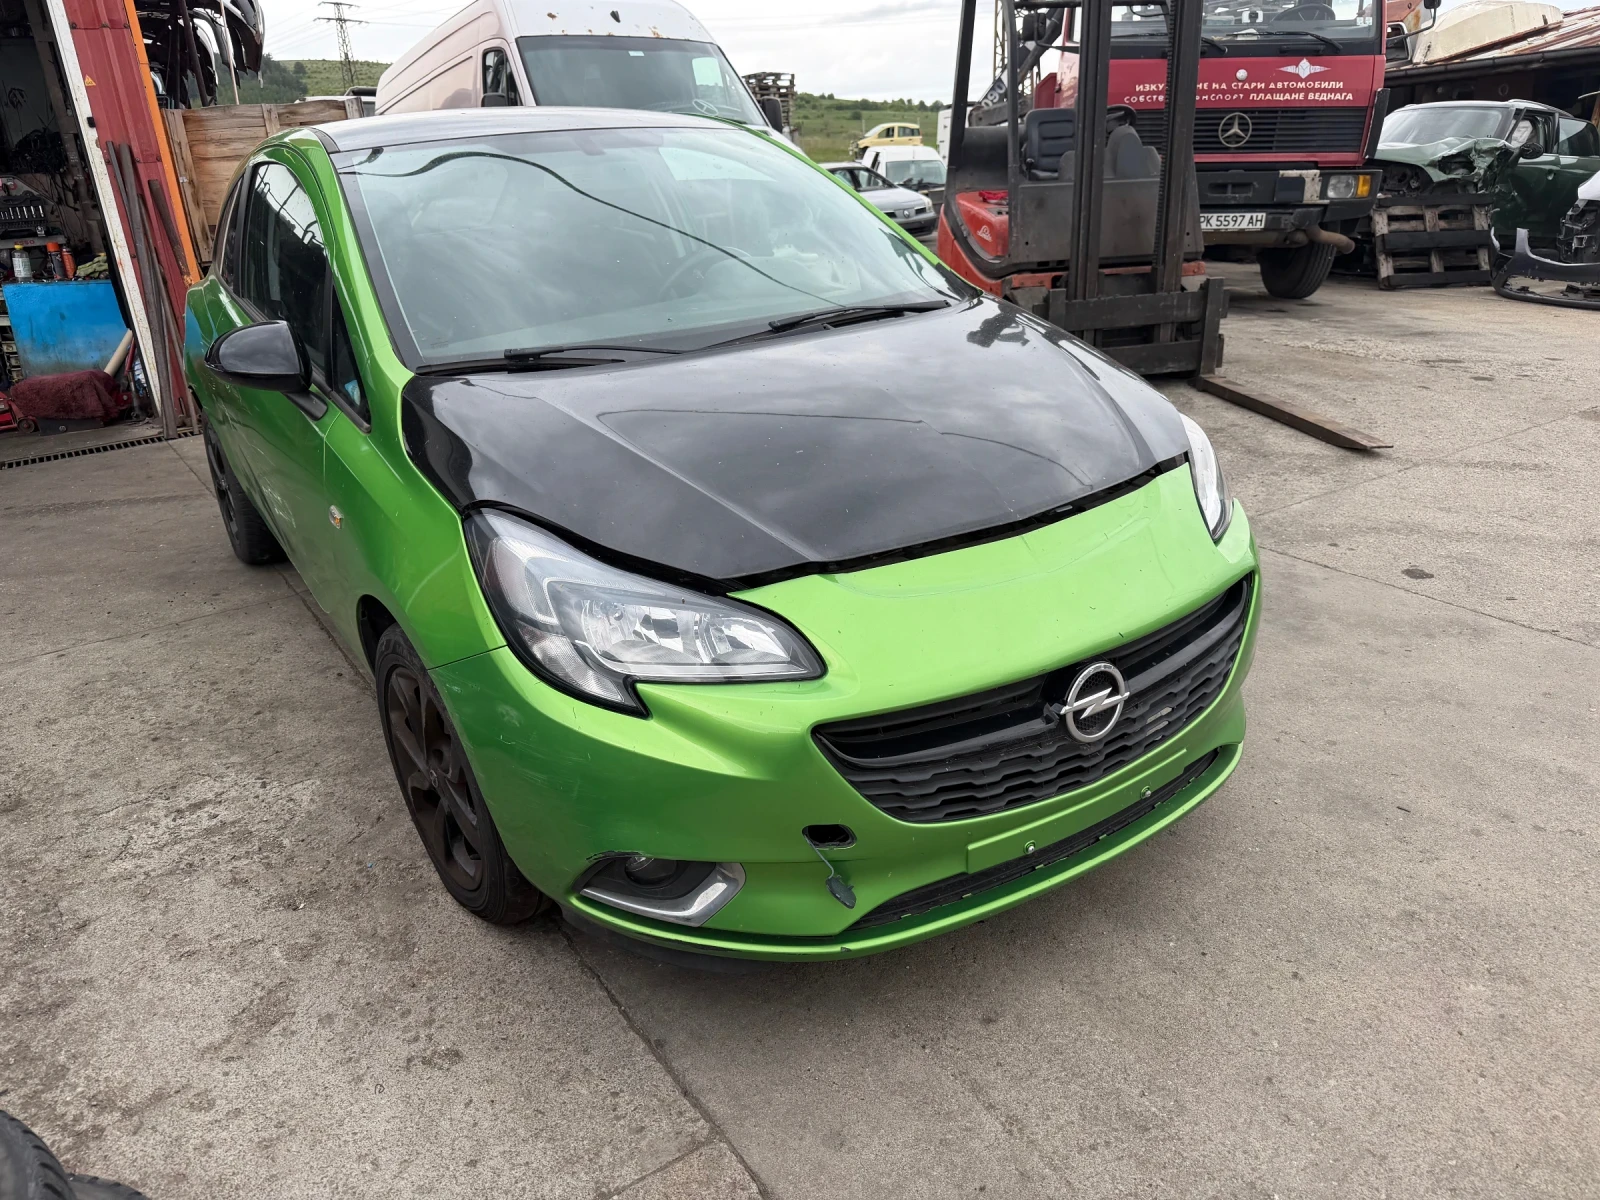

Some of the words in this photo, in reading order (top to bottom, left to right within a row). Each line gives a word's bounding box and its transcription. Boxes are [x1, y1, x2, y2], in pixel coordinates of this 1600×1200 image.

[1212, 82, 1227, 90] НА
[1231, 82, 1265, 90] СТАРИ
[1268, 81, 1344, 89] АВТОМОБИЛИ
[1124, 94, 1165, 103] СОБСТВ
[1249, 92, 1305, 101] ПЛАЩАНЕ
[1307, 92, 1354, 101] ВЕДНАГА
[1215, 215, 1246, 227] 5597
[1247, 214, 1264, 227] AH
